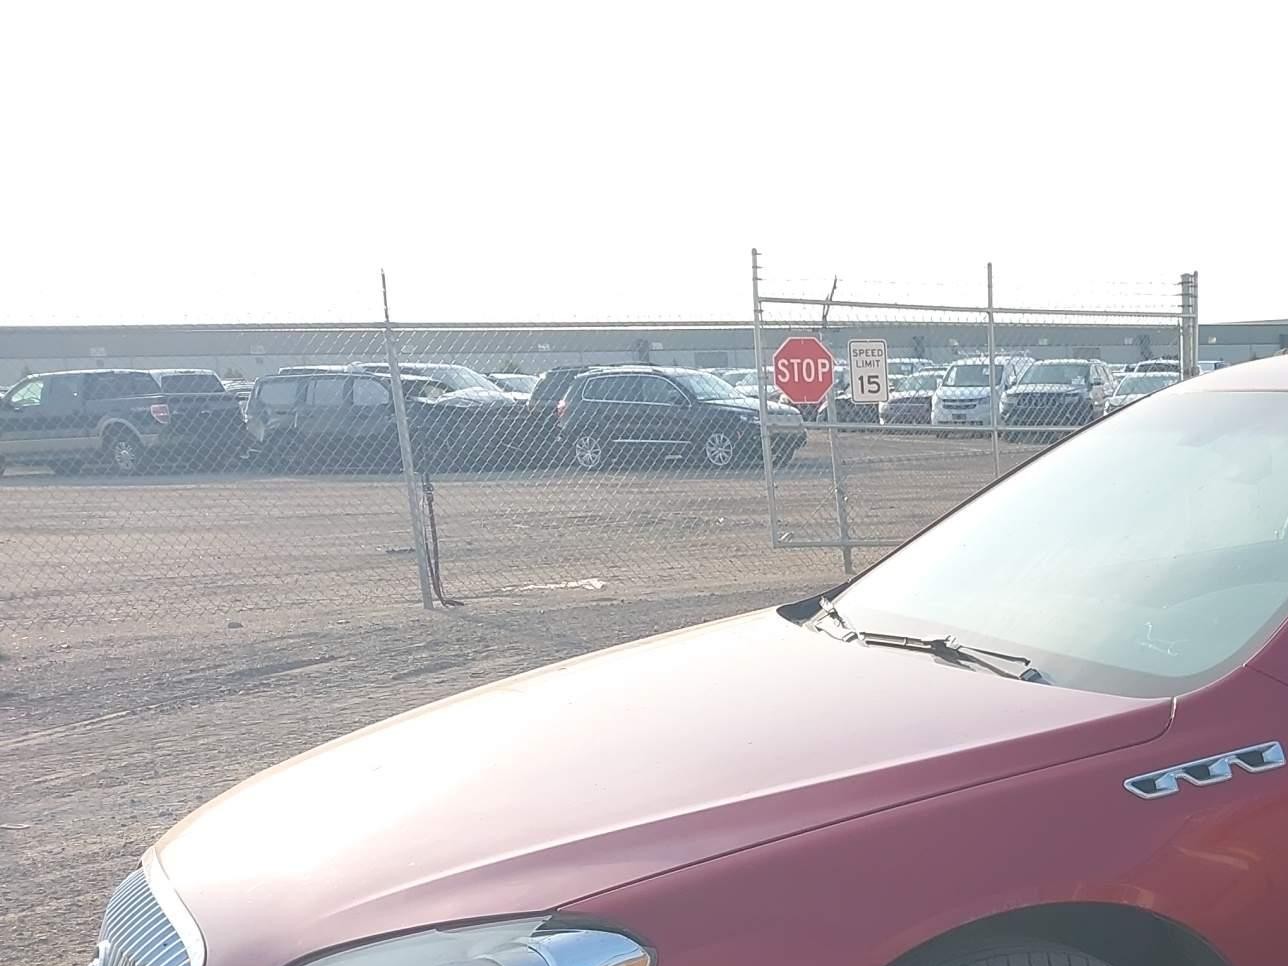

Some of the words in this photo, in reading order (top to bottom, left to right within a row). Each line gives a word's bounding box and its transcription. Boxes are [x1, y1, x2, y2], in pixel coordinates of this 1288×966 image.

[852, 348, 884, 358] SPEED
[777, 358, 830, 383] STOP
[855, 359, 881, 369] LIMIT
[858, 375, 881, 395] 15
